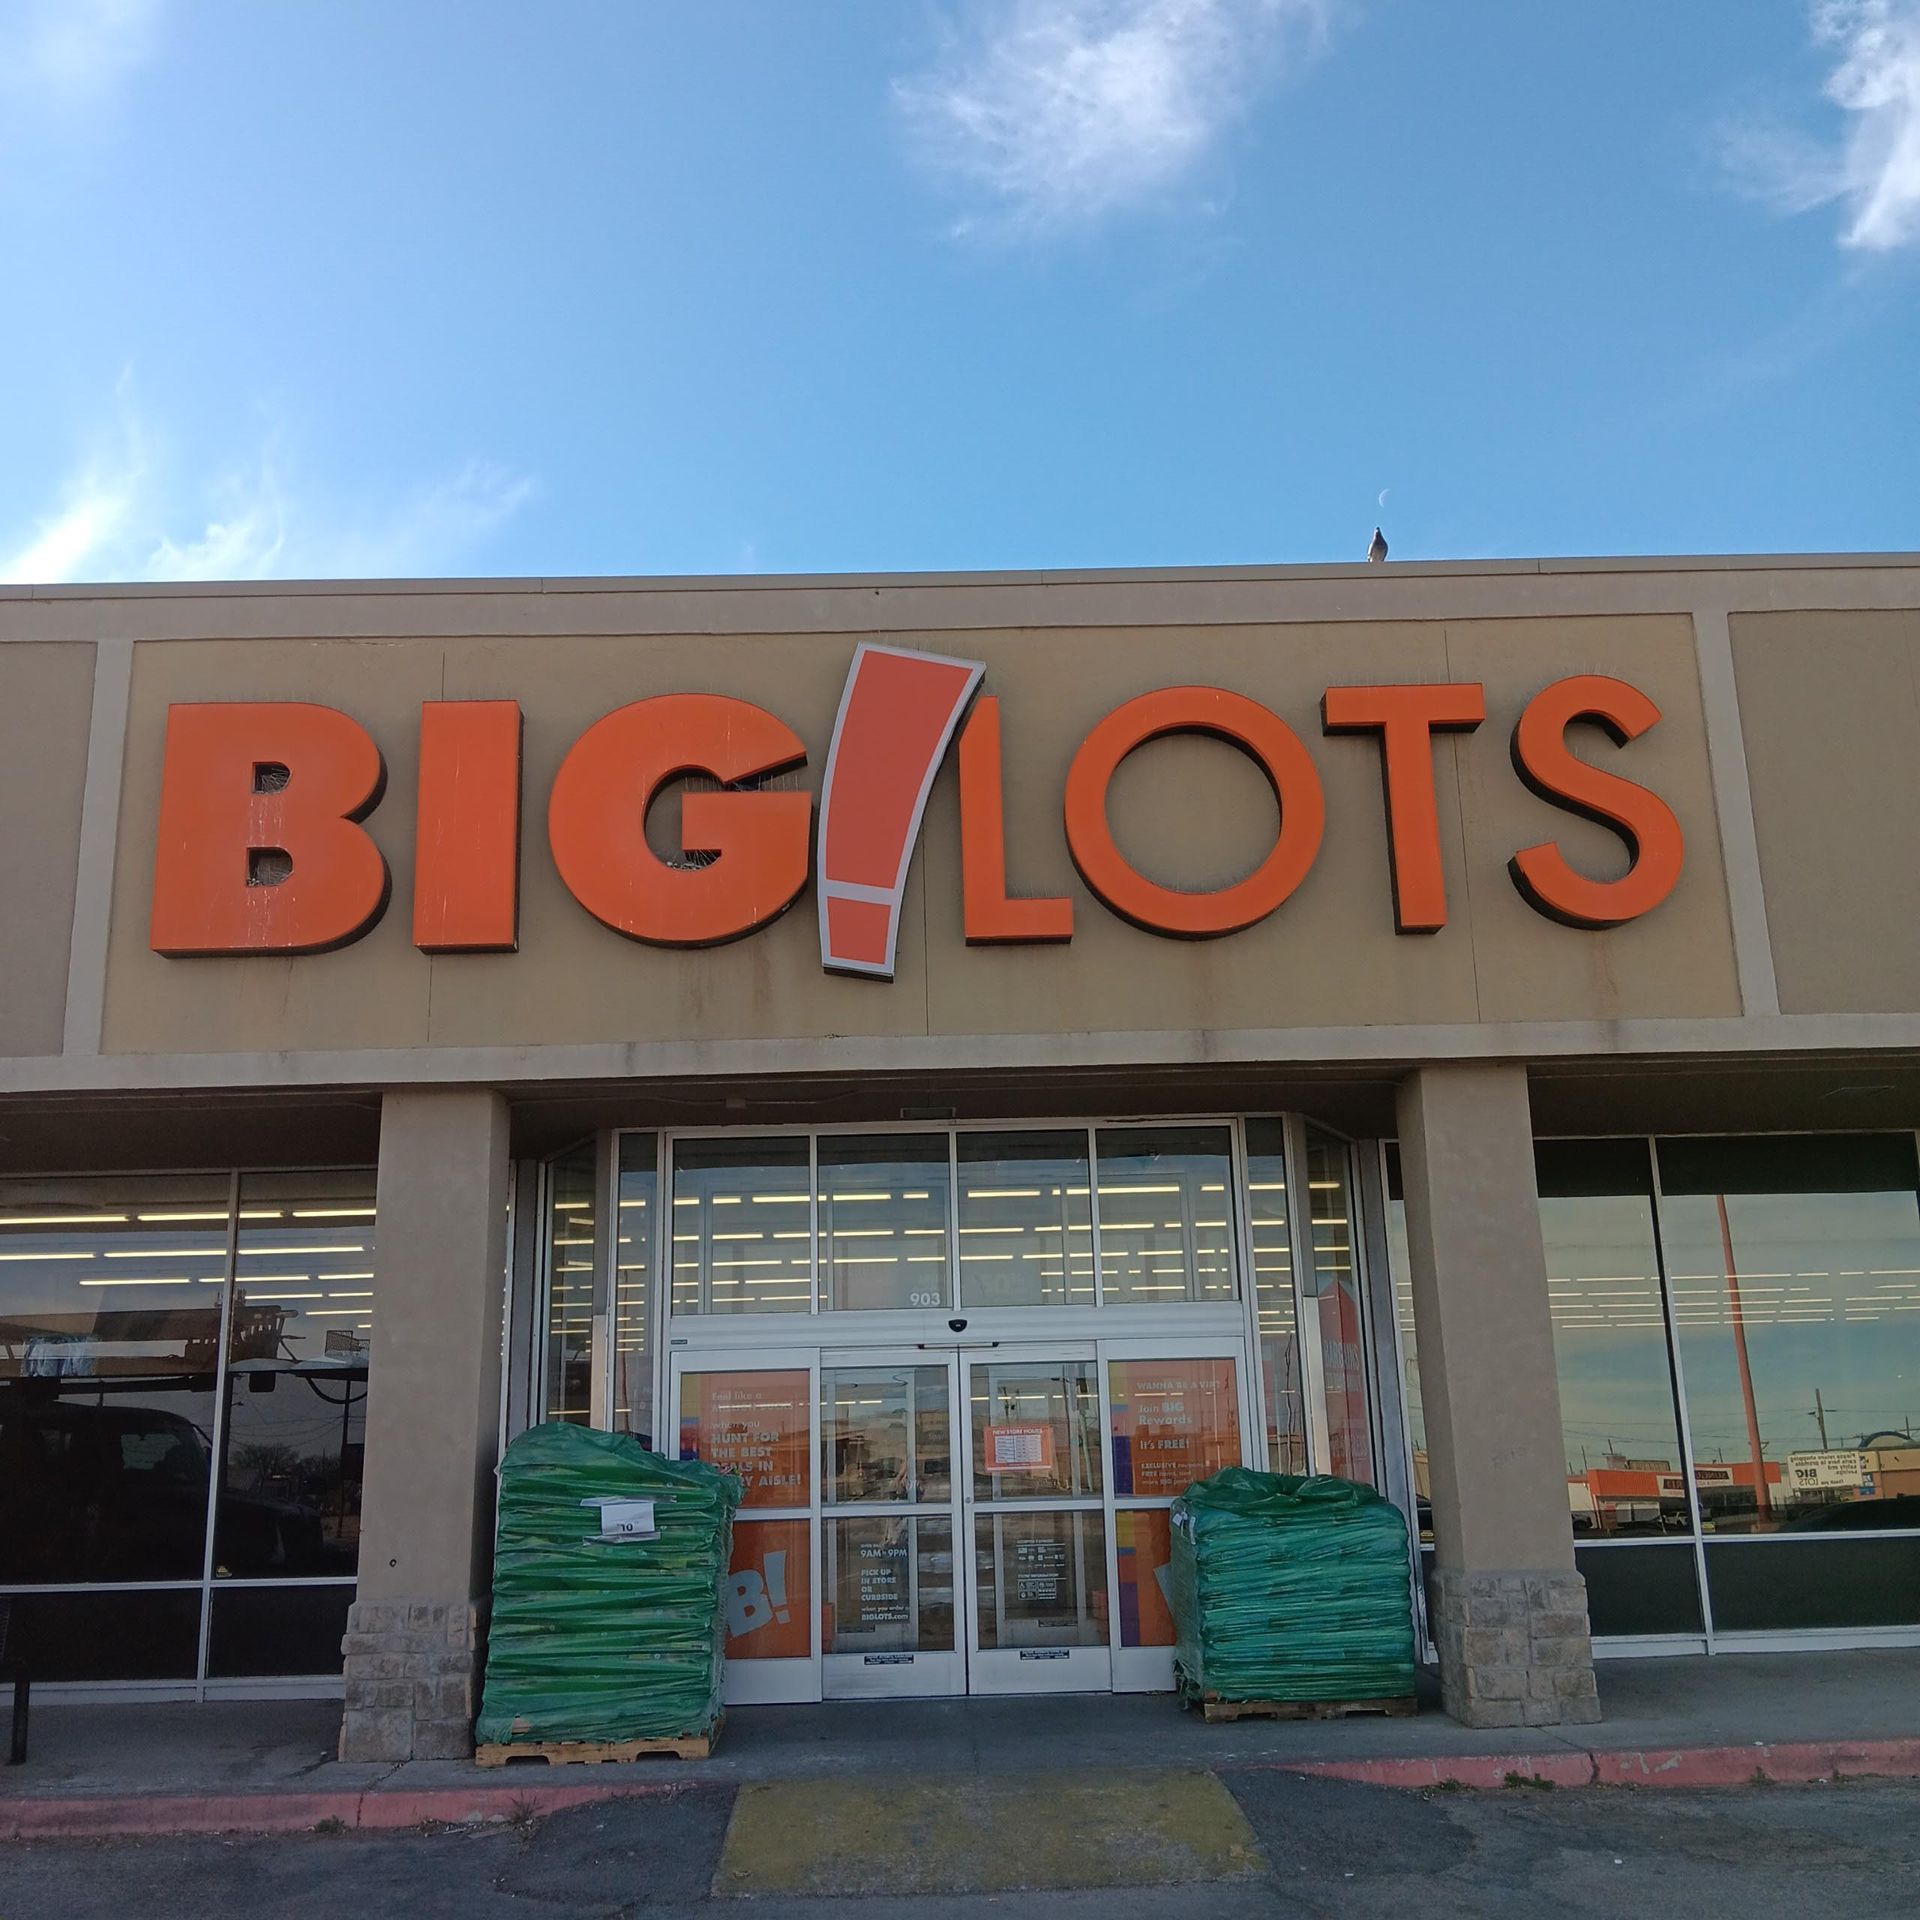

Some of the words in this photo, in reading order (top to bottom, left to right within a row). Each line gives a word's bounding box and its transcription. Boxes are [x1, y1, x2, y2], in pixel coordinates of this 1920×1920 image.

[958, 673, 1685, 946] LOTS
[910, 1292, 941, 1306] 903
[1137, 1381, 1172, 1390] WANNA
[712, 1392, 731, 1401] Feel
[735, 1392, 752, 1400] like
[1140, 1404, 1159, 1413] Join
[1162, 1402, 1185, 1412] BIG
[1140, 1414, 1192, 1425] Rewards
[741, 1421, 760, 1431] you
[712, 1433, 748, 1444] HUNT
[752, 1431, 779, 1442] FOR
[1140, 1440, 1155, 1450] It's
[1158, 1439, 1189, 1449] FREE!
[711, 1447, 736, 1458] THE
[741, 1446, 773, 1457] BEST
[758, 1460, 774, 1472] IN
[759, 1473, 801, 1486] AISLE!
[860, 1549, 881, 1558] 9AM
[888, 1548, 908, 1558] 9PM
[872, 1576, 896, 1584] STORE
[861, 1613, 908, 1621] BIGLOTS.com
